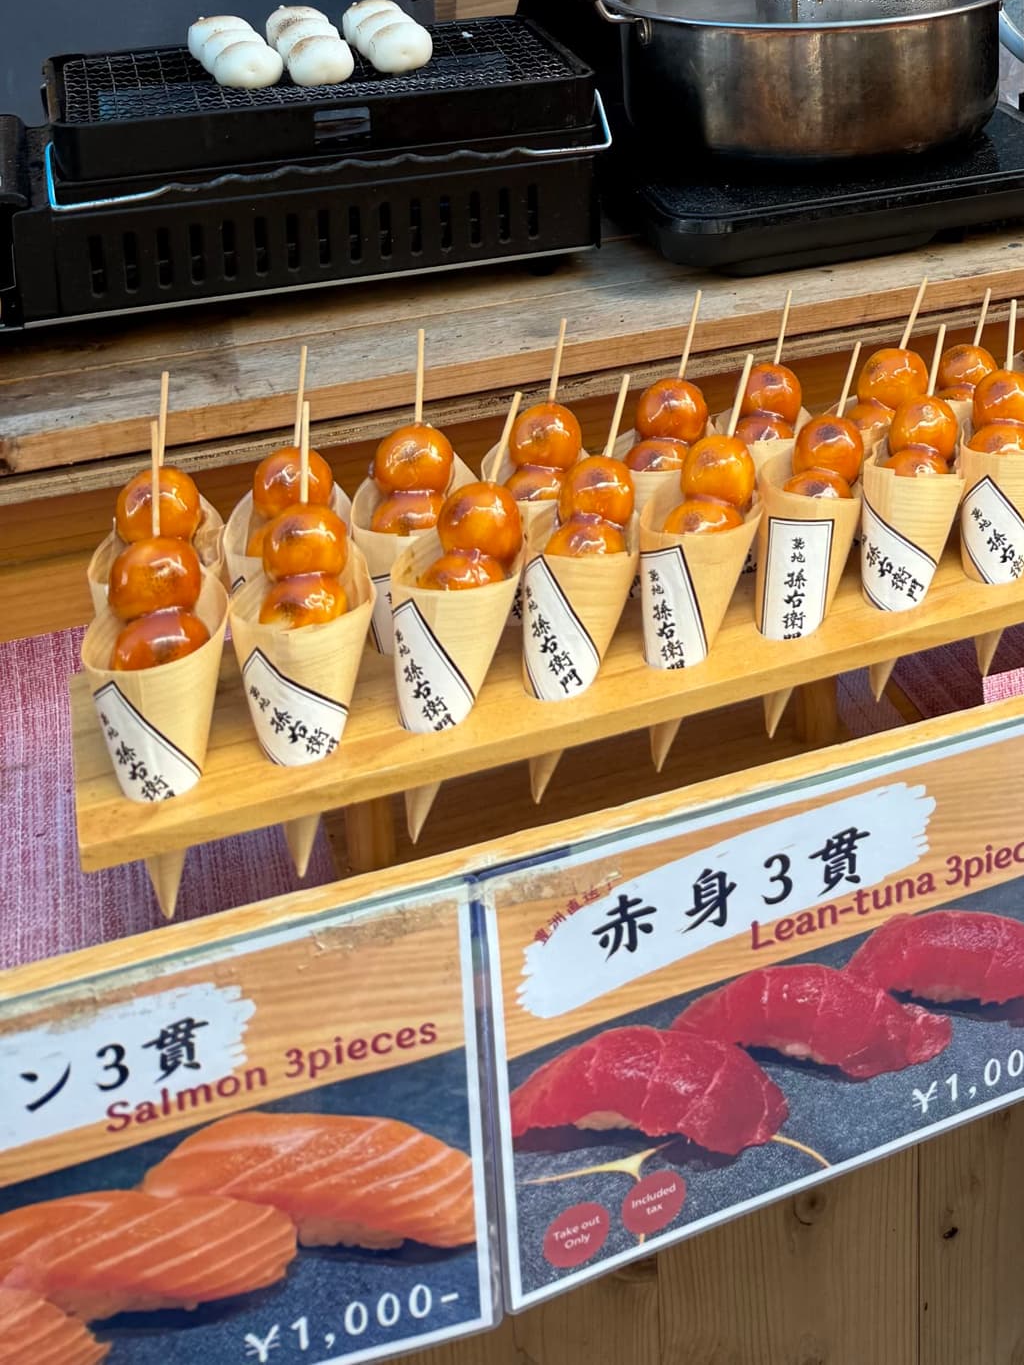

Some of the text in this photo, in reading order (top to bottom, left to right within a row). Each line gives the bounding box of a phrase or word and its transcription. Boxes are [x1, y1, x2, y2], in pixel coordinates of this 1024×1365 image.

[592, 827, 870, 961] 赤身3貫
[750, 873, 936, 951] Lean-tuna
[20, 1017, 208, 1112] ン3貫
[106, 1022, 438, 1133] Salmon 3pieces
[553, 1216, 600, 1241] Take out
[631, 1184, 676, 1210] Included
[646, 1203, 663, 1216] tax
[564, 1234, 591, 1250] Only
[244, 1284, 459, 1362] ¥1,000-
